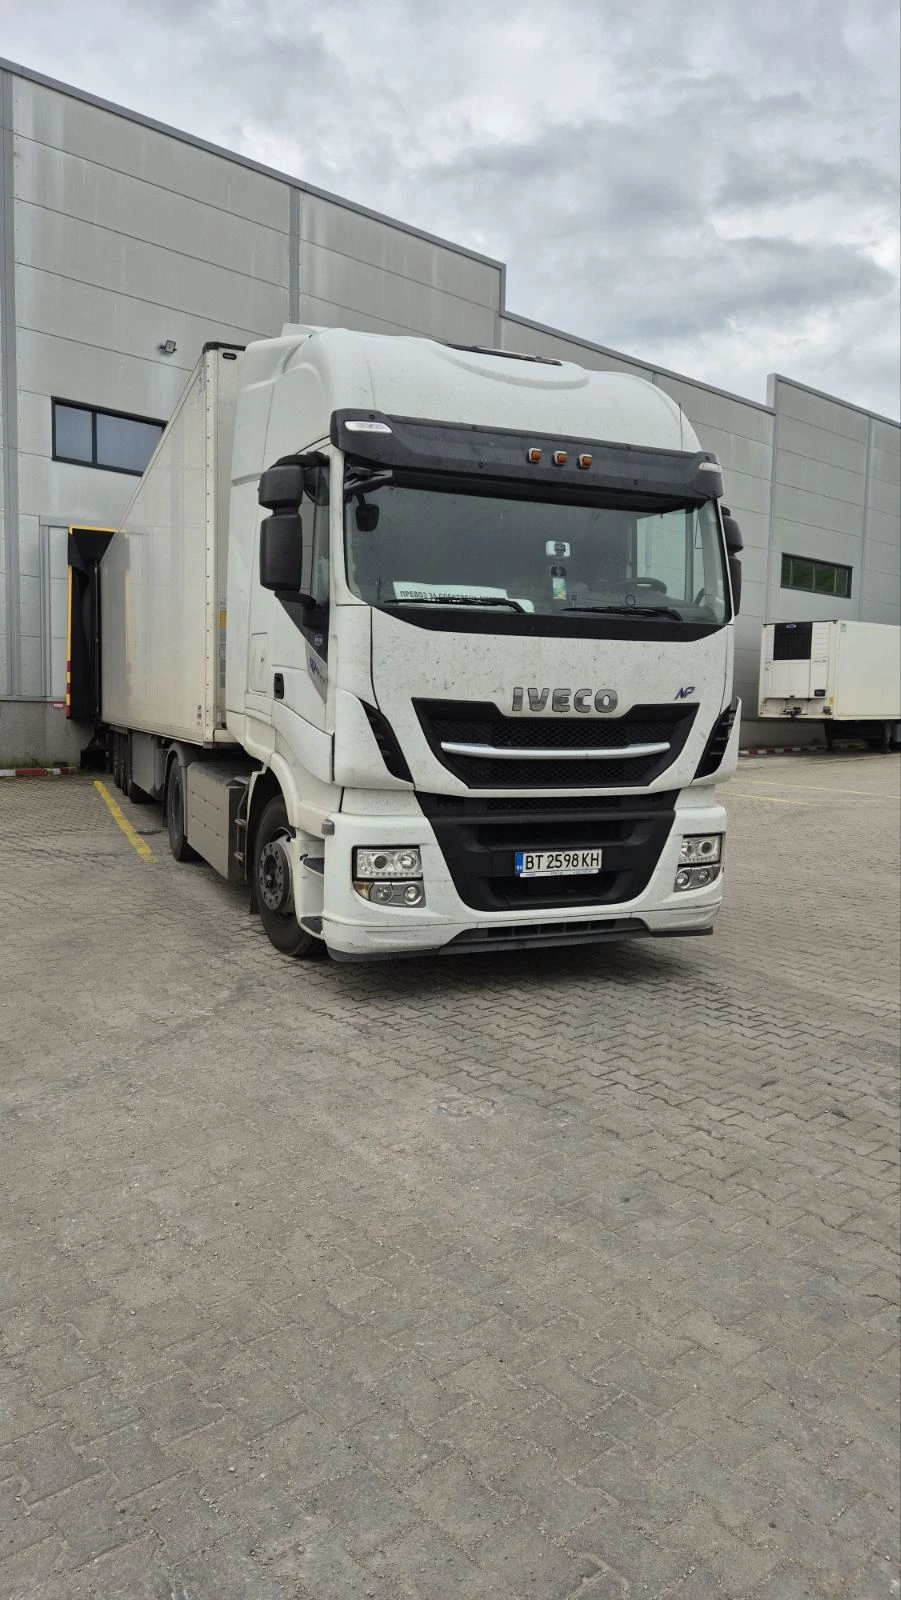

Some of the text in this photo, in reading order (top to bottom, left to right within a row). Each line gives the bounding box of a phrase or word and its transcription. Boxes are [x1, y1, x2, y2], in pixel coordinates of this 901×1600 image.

[400, 590, 427, 598] ПРЕВОЗ
[512, 687, 618, 713] IVECO
[525, 852, 599, 870] BT 2598 KH
